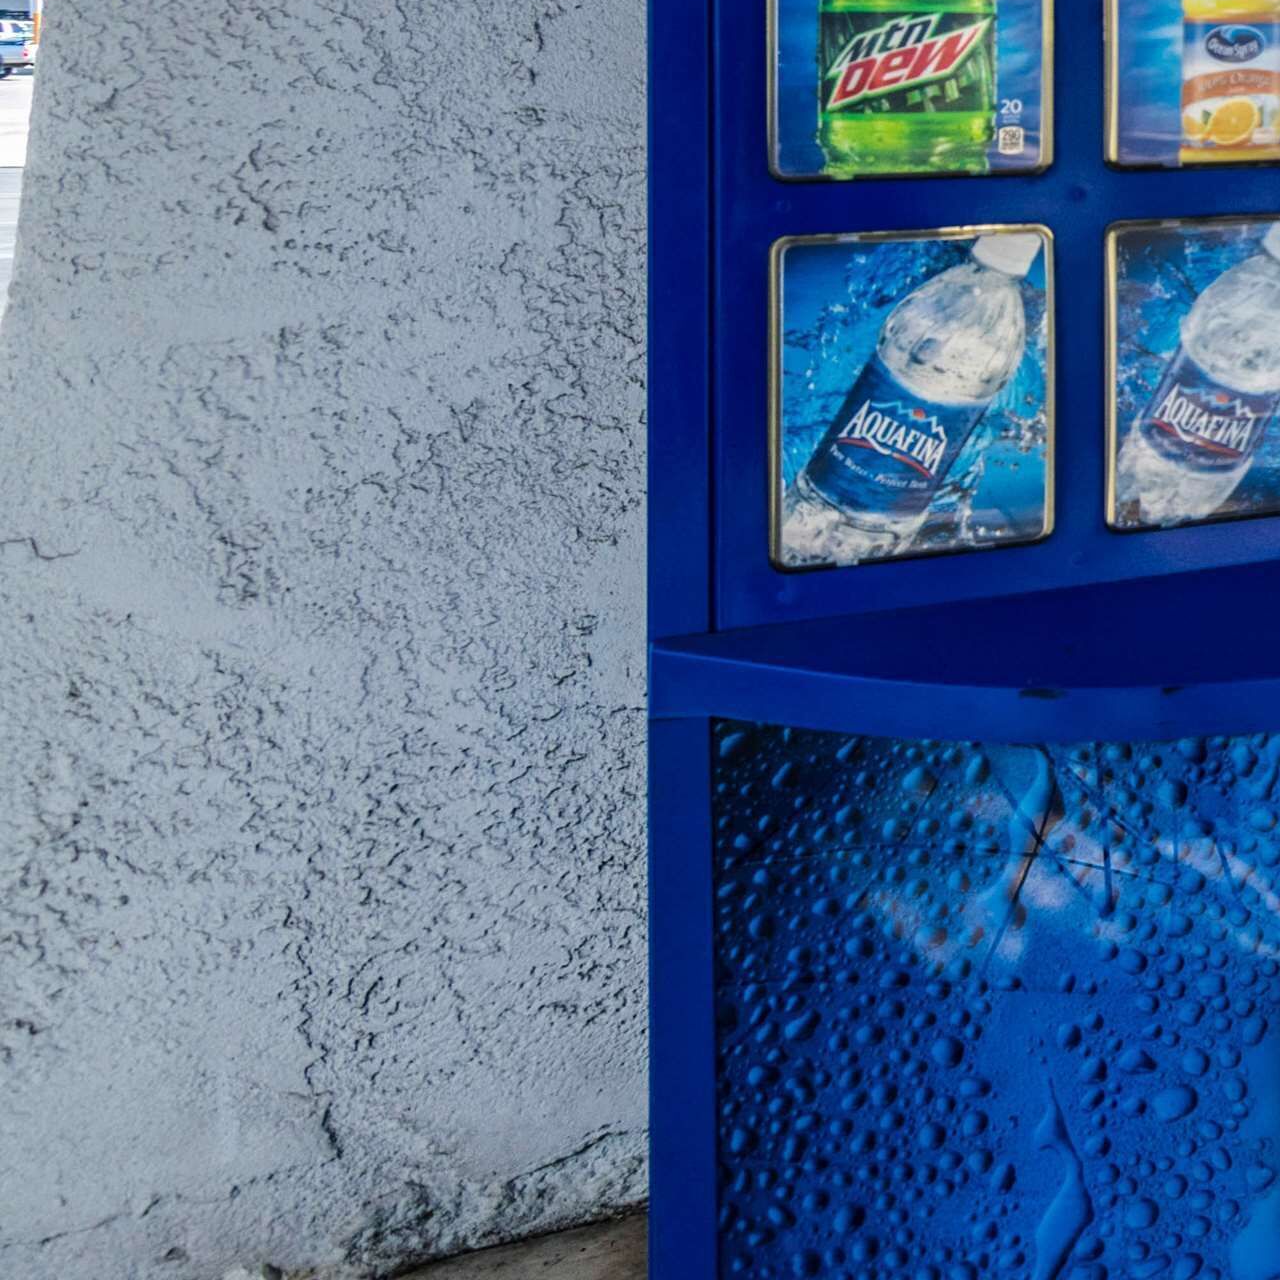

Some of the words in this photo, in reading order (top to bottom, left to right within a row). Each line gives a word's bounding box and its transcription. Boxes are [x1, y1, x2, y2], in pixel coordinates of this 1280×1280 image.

[1000, 99, 1022, 114] 20
[837, 399, 948, 475] AQUAFINA
[1152, 382, 1257, 453] AQUAFINA
